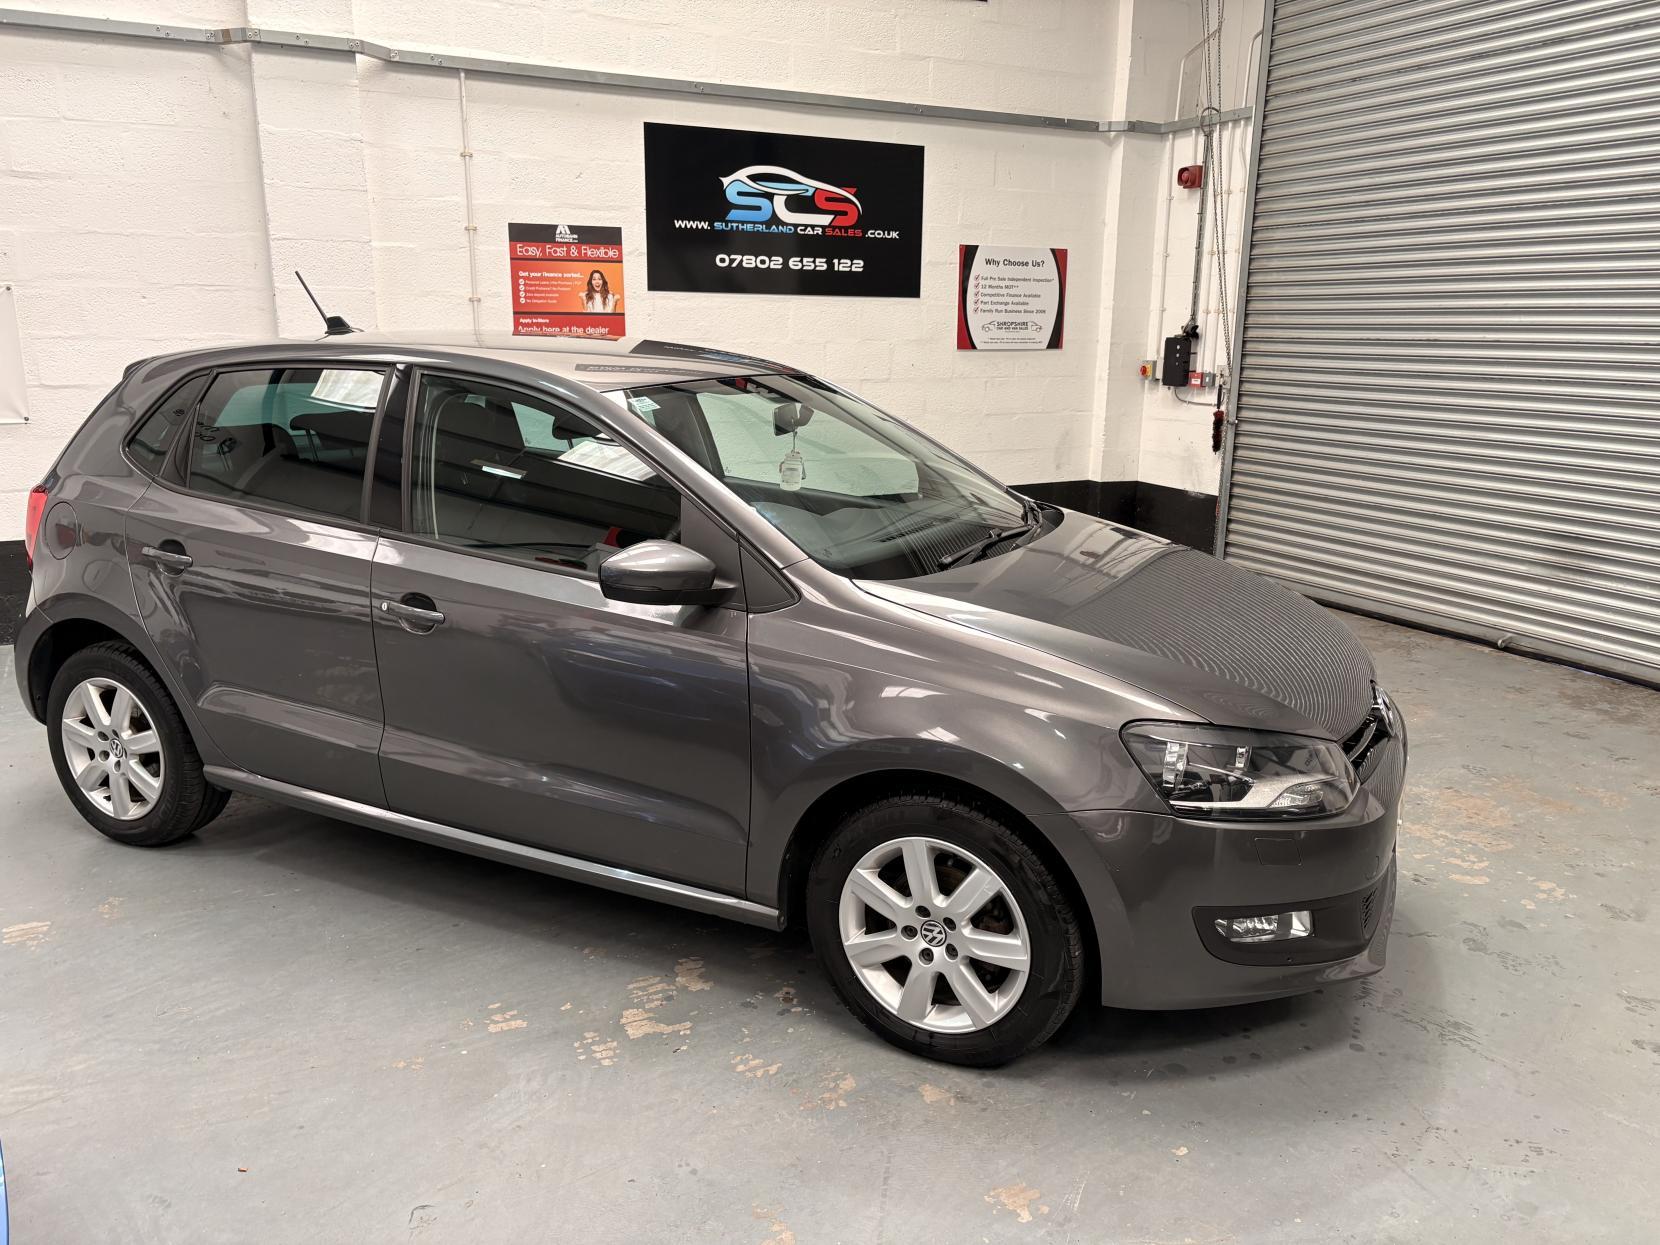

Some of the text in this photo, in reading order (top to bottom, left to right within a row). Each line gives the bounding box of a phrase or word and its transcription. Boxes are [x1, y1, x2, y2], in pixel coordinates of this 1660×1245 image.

[713, 222, 794, 234] SUTHERLAND
[797, 225, 823, 236] CAR
[825, 227, 862, 237] SALES
[516, 243, 619, 258] Easy, Fast & Flexible
[715, 253, 864, 272] 07802 655 122
[985, 258, 1045, 268] Why Choose Us?
[571, 326, 584, 334] the
[585, 326, 610, 334] dealer
